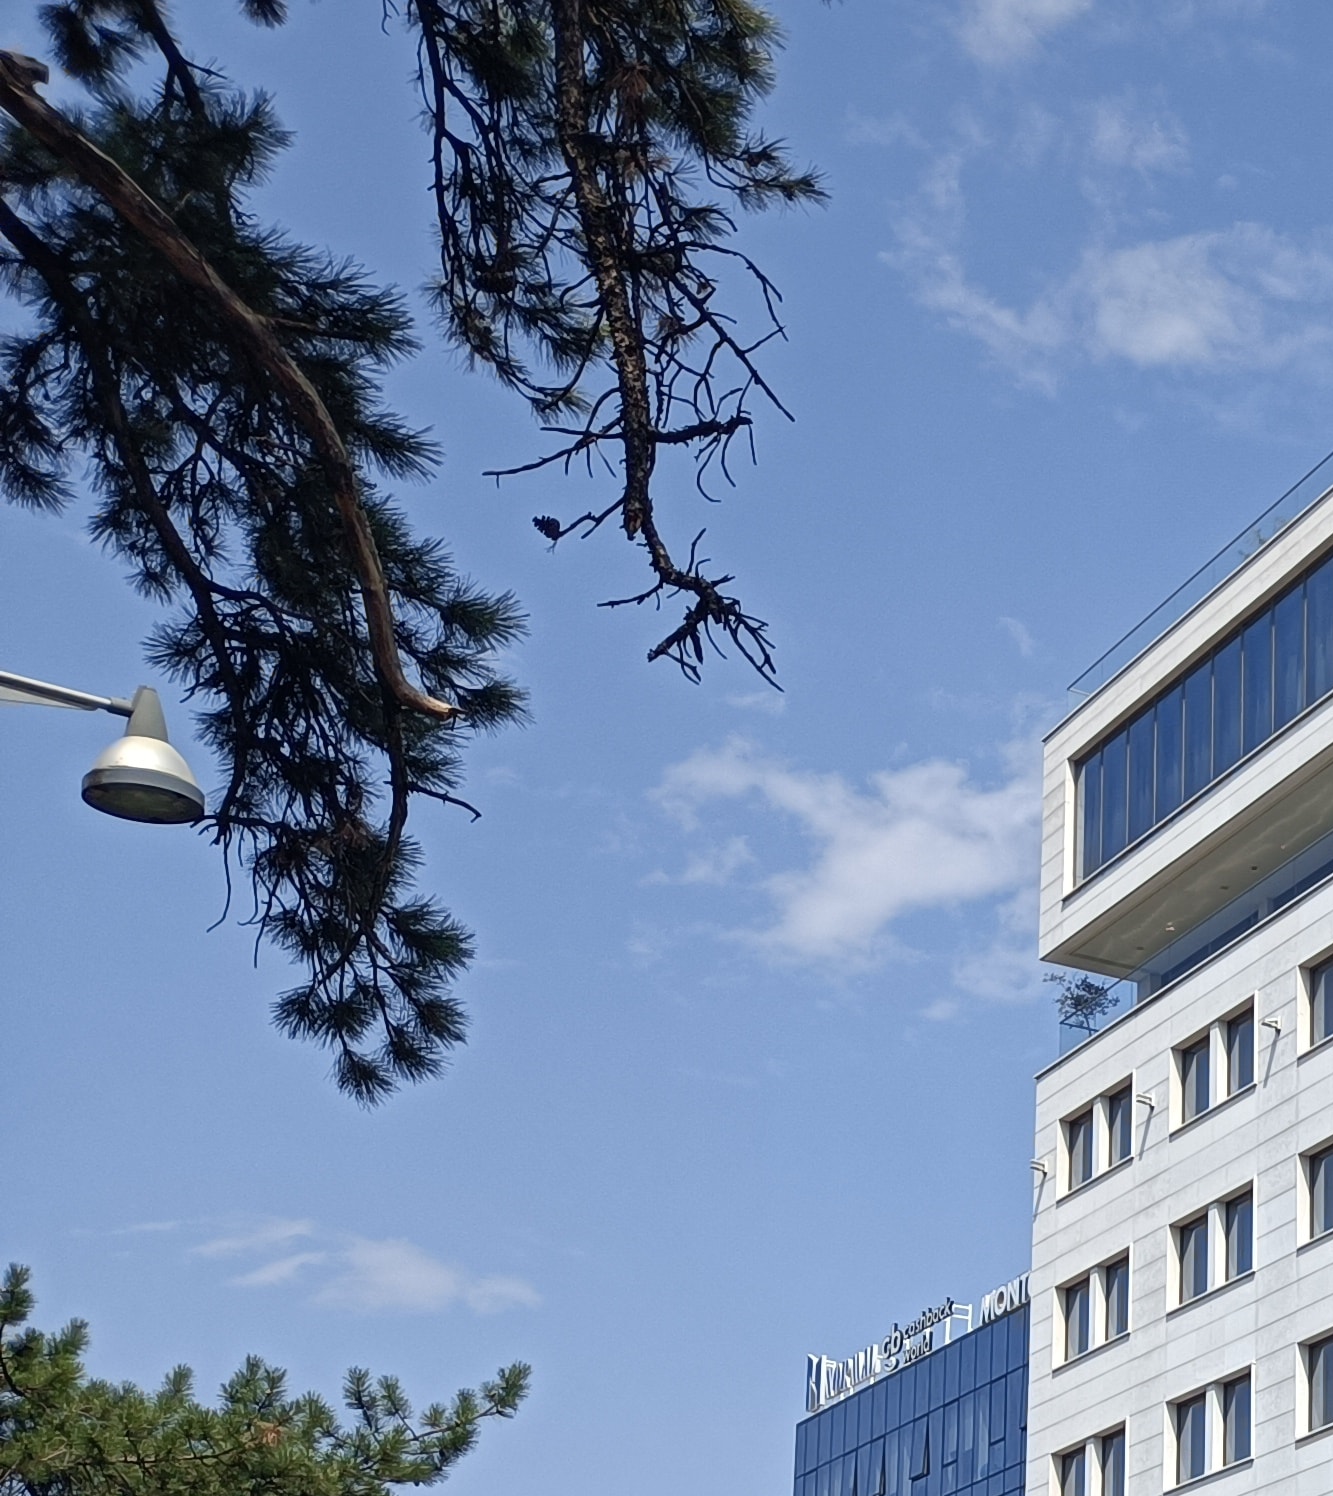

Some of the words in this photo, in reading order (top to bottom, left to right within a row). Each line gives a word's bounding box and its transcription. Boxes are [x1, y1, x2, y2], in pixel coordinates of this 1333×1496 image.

[903, 1297, 954, 1340] cashback
[979, 1270, 1032, 1326] MONT
[903, 1331, 933, 1364] world
